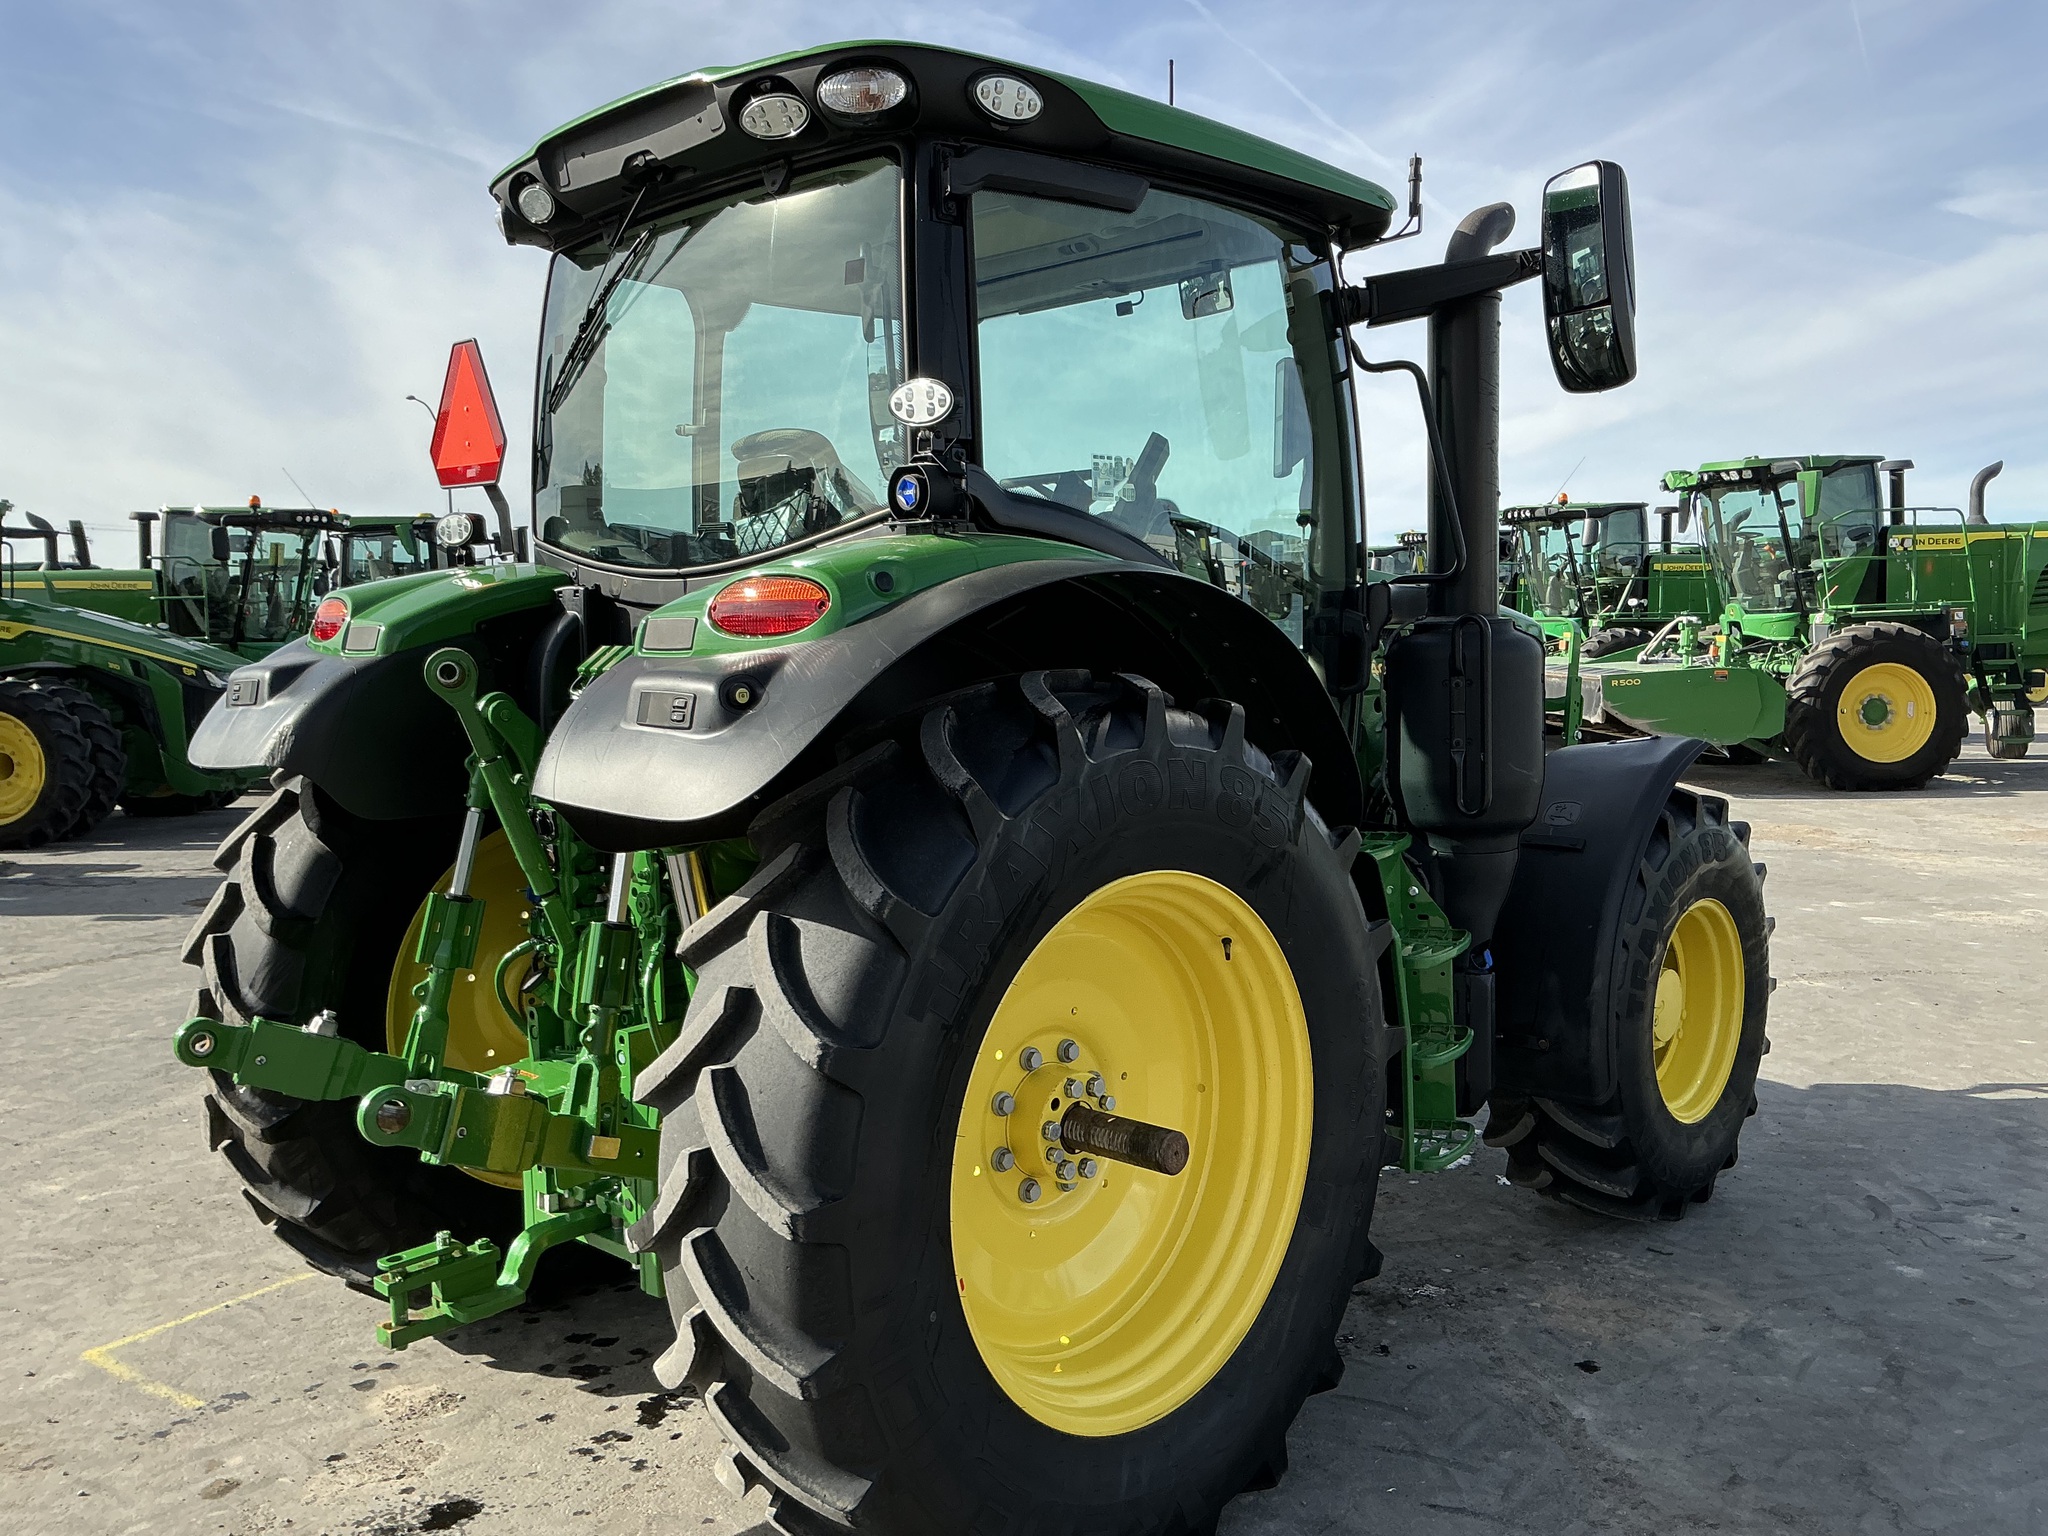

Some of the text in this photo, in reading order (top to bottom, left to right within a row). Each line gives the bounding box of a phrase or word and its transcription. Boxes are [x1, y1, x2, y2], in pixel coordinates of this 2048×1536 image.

[1928, 537, 1961, 545] DEERE
[1620, 678, 1641, 686] 500
[1698, 832, 1727, 865] 85
[906, 758, 1291, 1025] TRAXION 85
